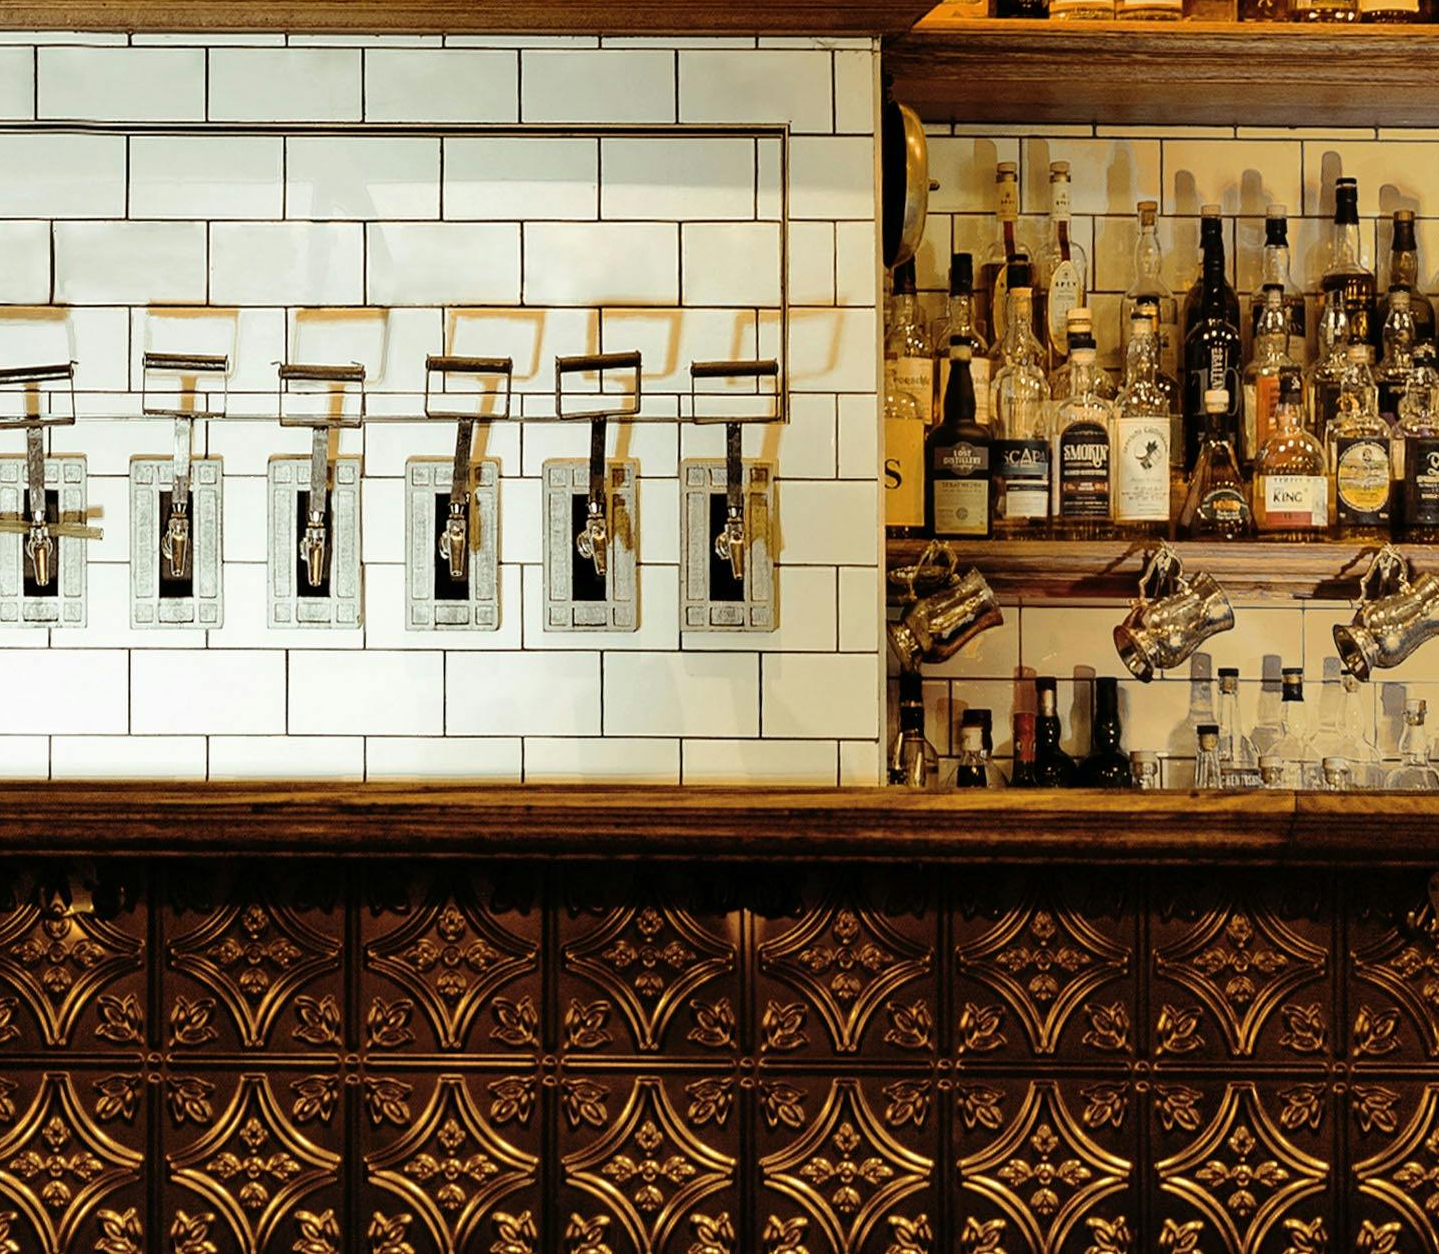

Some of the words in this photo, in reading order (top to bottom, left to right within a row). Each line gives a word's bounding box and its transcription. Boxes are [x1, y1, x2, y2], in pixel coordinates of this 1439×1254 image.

[1003, 446, 1047, 462] SCAPA
[883, 458, 903, 490] S
[1273, 490, 1302, 503] KING
